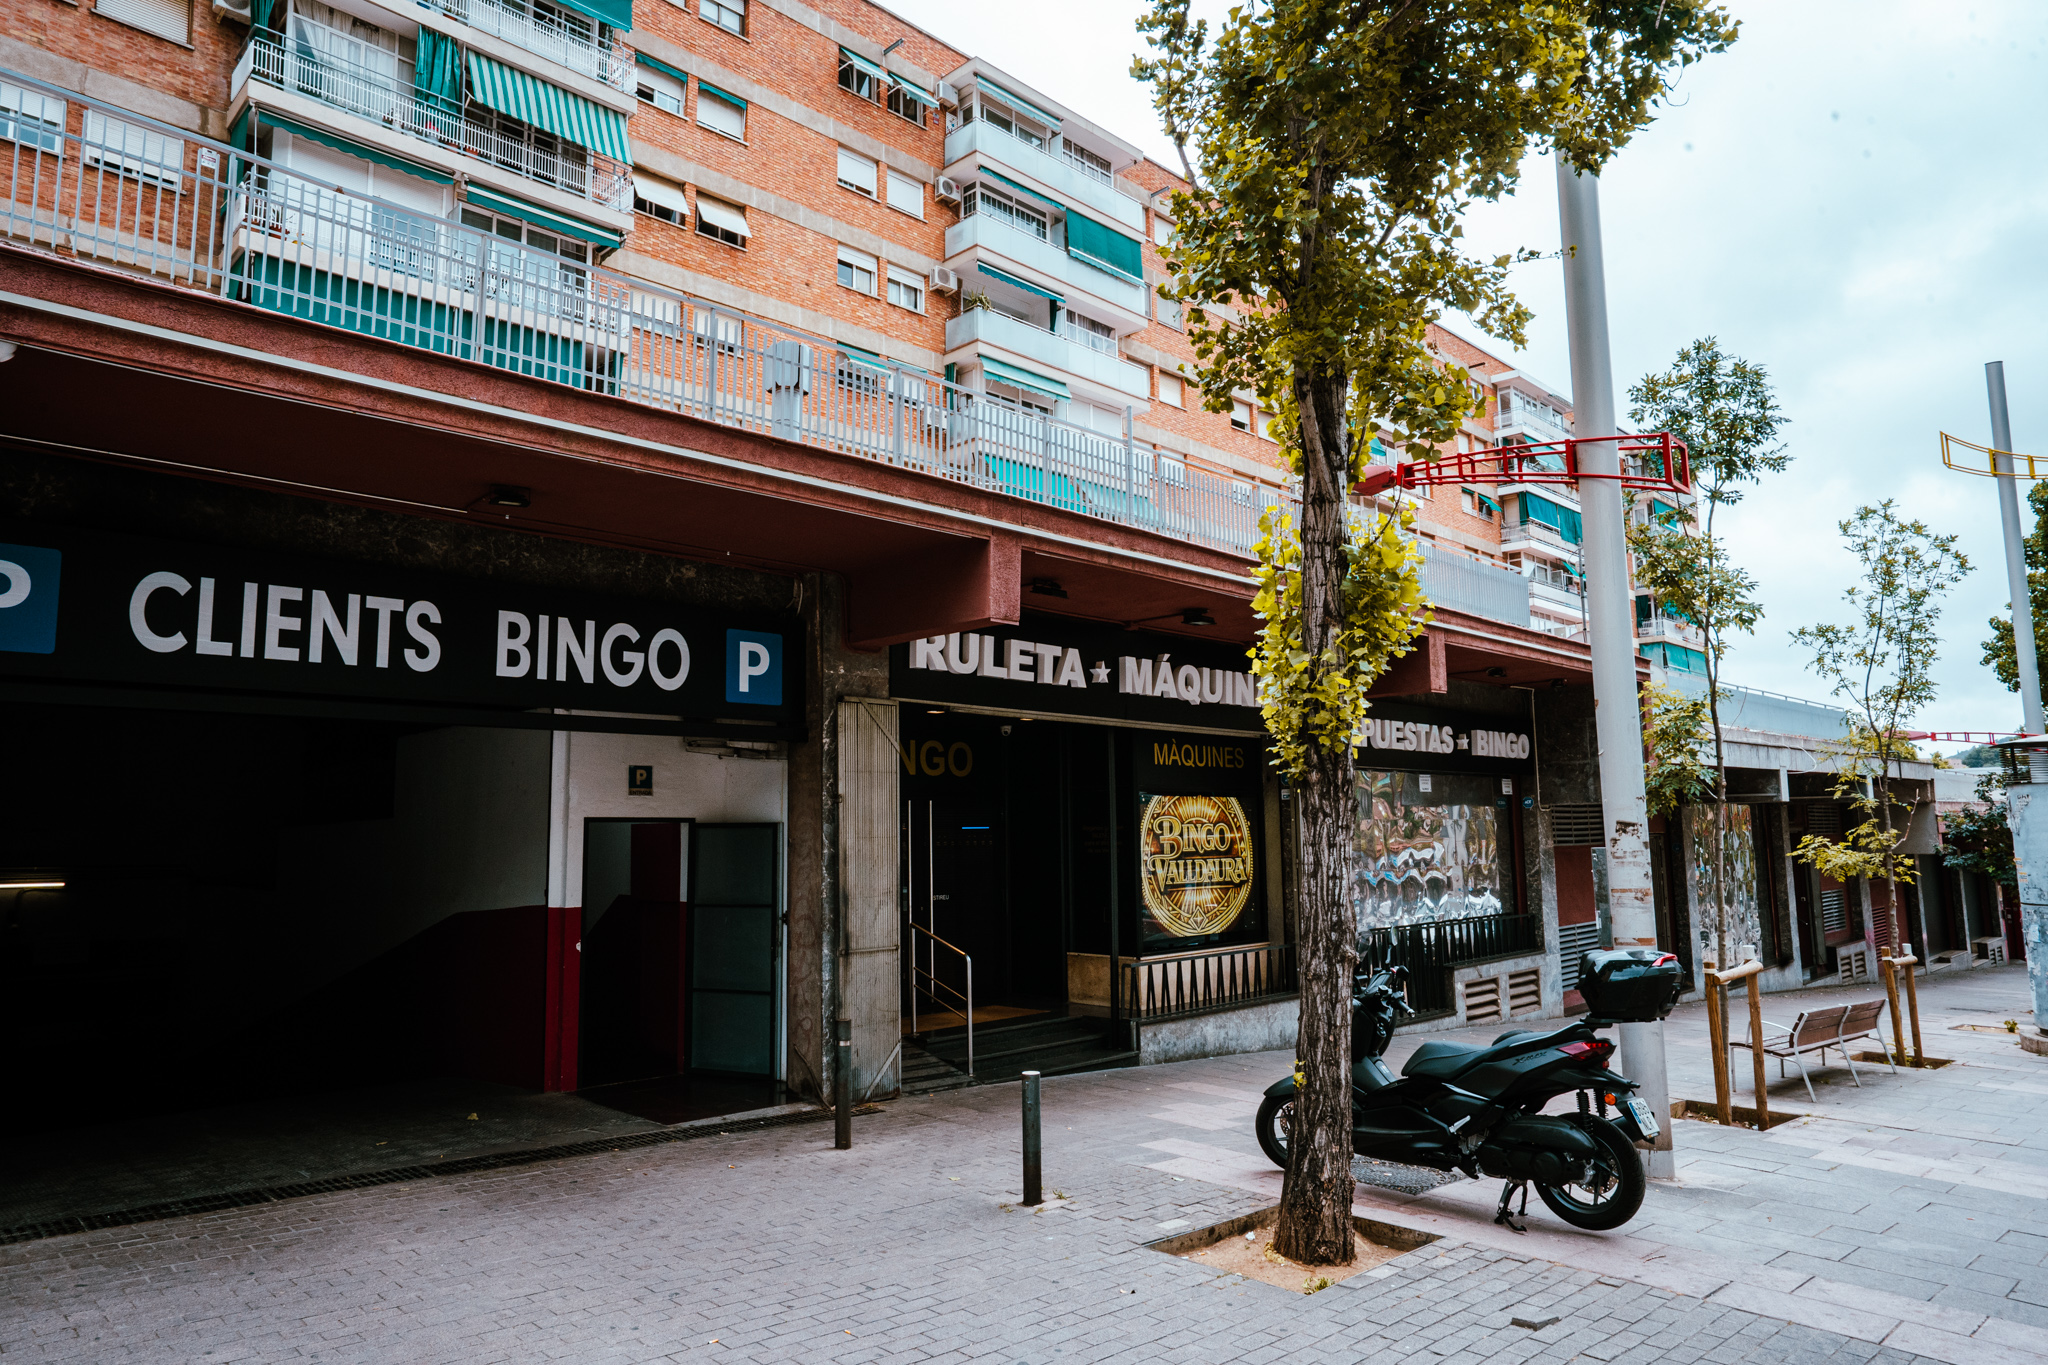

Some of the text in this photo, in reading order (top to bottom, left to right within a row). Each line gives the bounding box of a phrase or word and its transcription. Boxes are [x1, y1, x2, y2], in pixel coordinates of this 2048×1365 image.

[129, 571, 442, 672] CLIENTS
[496, 611, 690, 691] BINGO
[739, 642, 770, 693] P
[909, 632, 1265, 709] RULETA MÁQUIN
[899, 739, 973, 777] NGO
[1153, 738, 1246, 769] MÀQUINES
[1352, 717, 1531, 760] PUESTAS BINGO
[636, 769, 647, 785] P
[1152, 815, 1231, 860] BINGO
[1147, 855, 1248, 893] VALLDAURA
